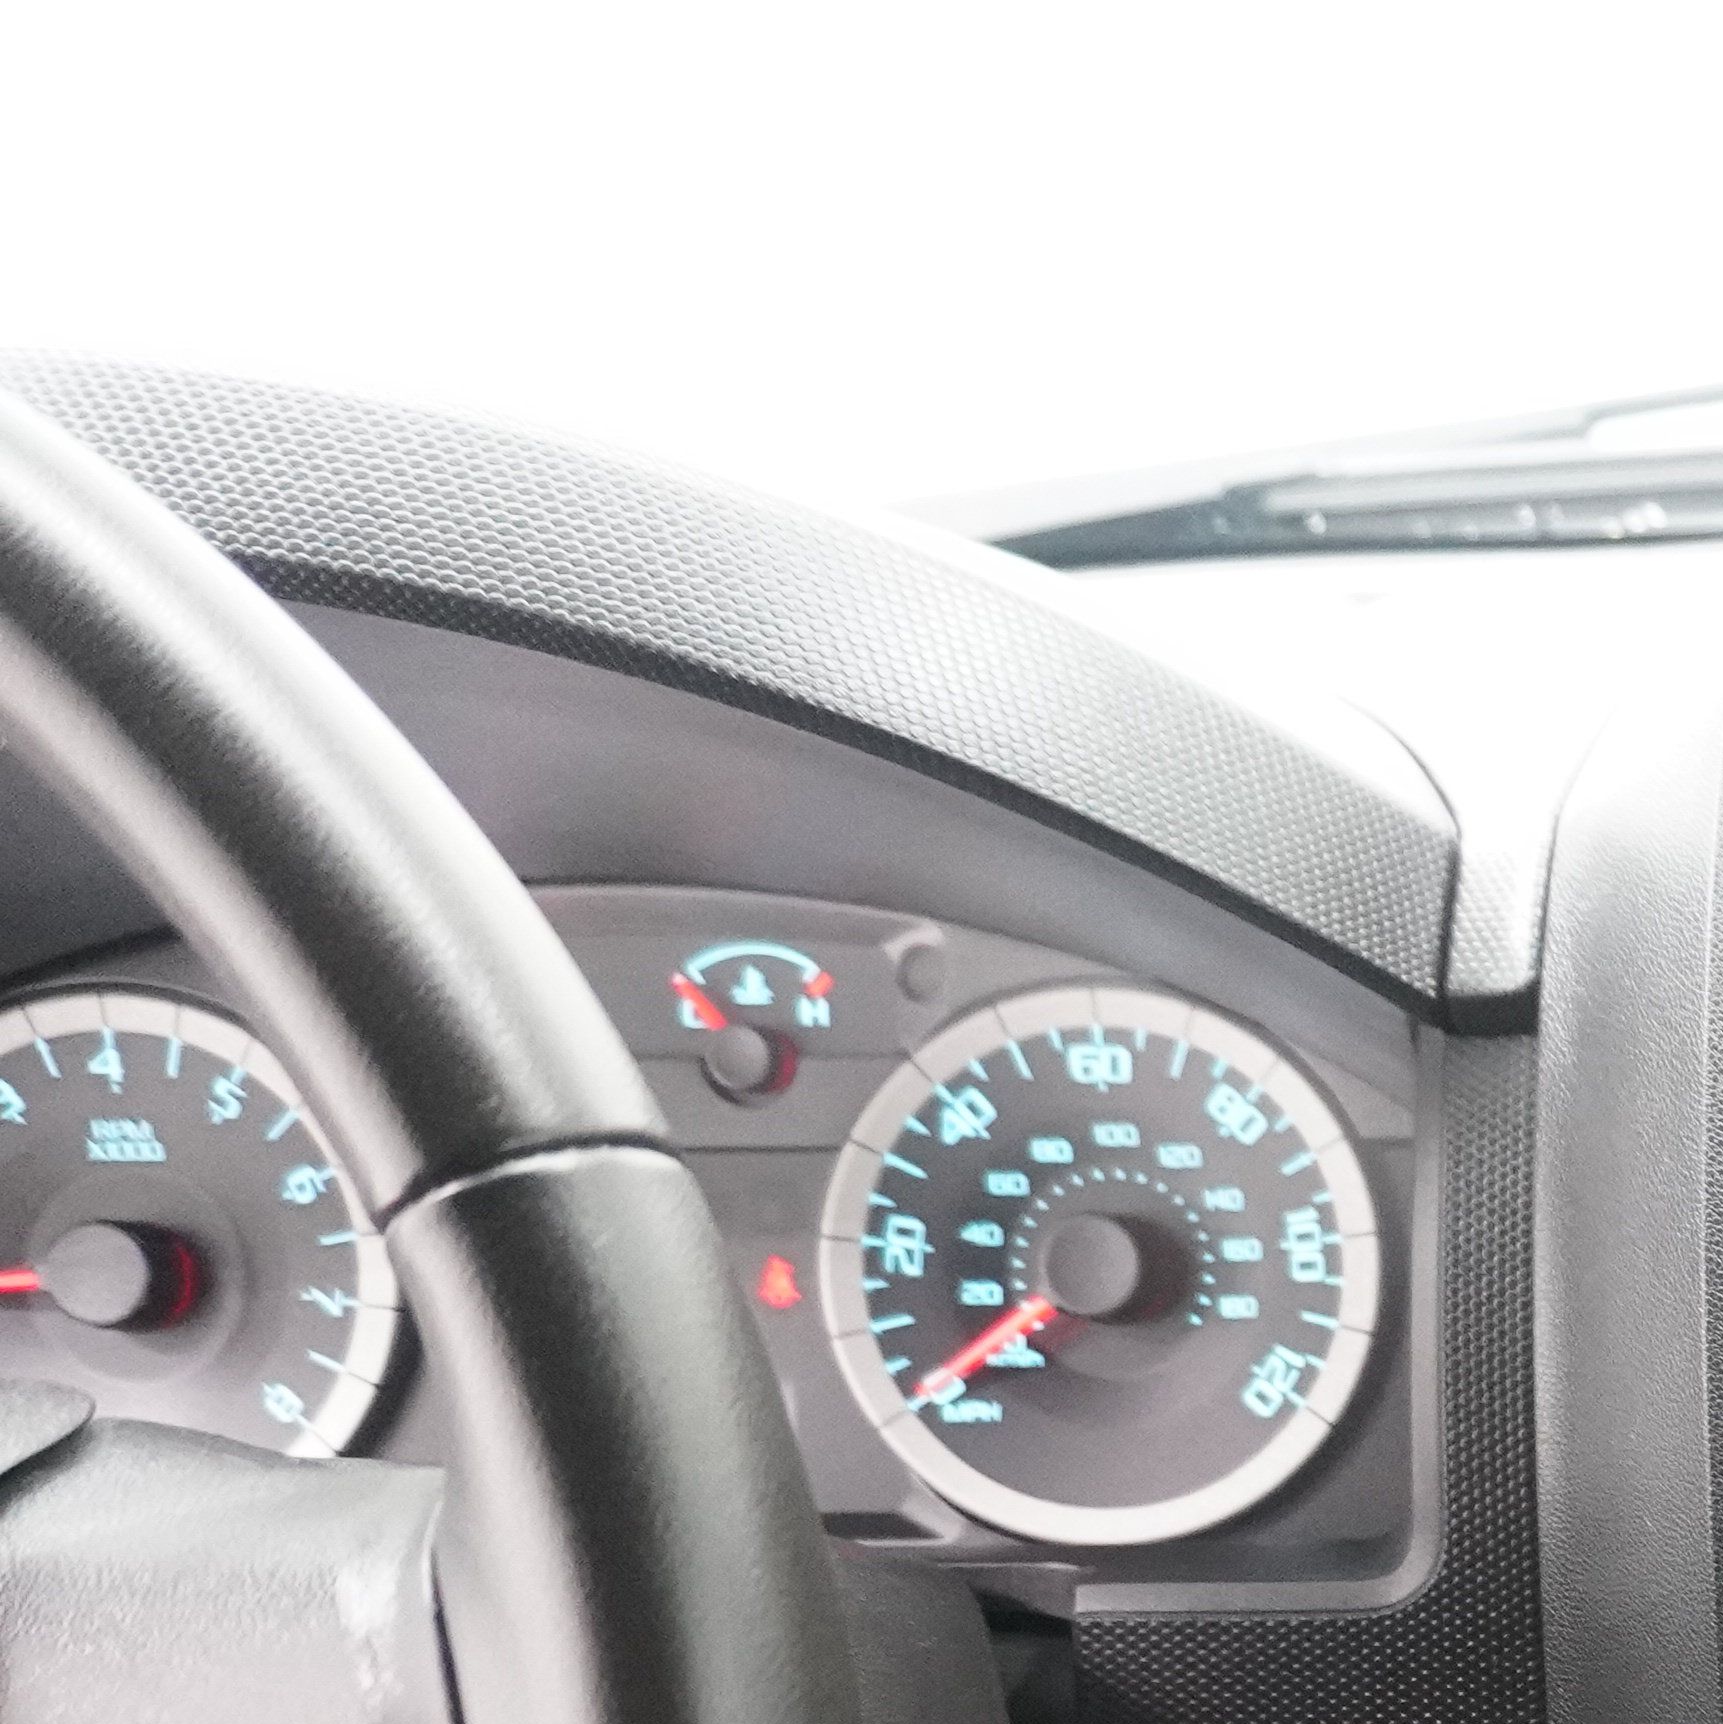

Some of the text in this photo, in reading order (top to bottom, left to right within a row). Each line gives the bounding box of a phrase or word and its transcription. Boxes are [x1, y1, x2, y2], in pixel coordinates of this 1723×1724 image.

[1066, 1042, 1133, 1086] 60
[940, 1086, 998, 1146] 40
[1204, 1082, 1270, 1147] 80
[883, 1214, 928, 1278] 20
[1285, 1206, 1327, 1284] 100
[1242, 1343, 1308, 1419] 120
